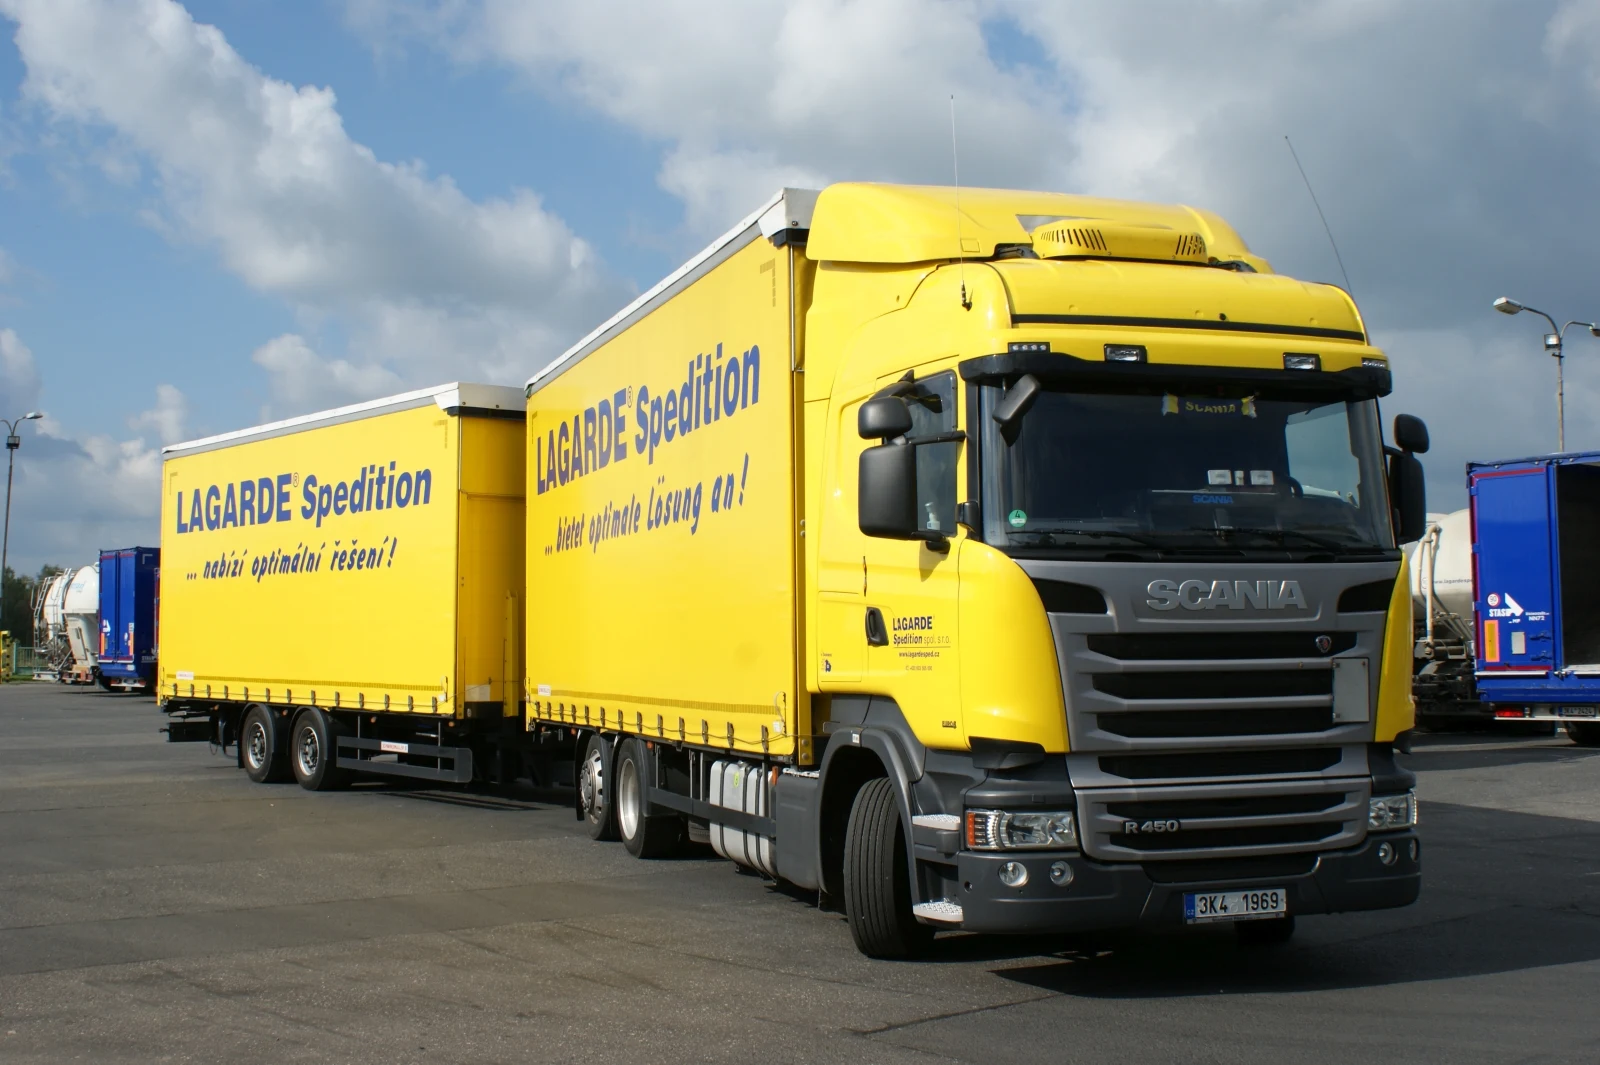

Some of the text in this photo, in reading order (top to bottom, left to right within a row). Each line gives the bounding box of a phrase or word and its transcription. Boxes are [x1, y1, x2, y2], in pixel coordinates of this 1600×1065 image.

[635, 342, 760, 465] Spedition
[301, 461, 432, 528] Spedition
[1192, 494, 1234, 504] SCANIA
[556, 513, 585, 553] bietet
[588, 493, 641, 554] optimale
[647, 475, 702, 536] Lösung
[203, 549, 247, 579] nabízí
[252, 542, 326, 583] optimální
[1146, 579, 1309, 611] SCANIA
[893, 616, 932, 630] LAGARDE
[893, 633, 923, 647] Spedition
[1125, 820, 1180, 834] R 450
[1198, 892, 1279, 914] 3K4 1969
